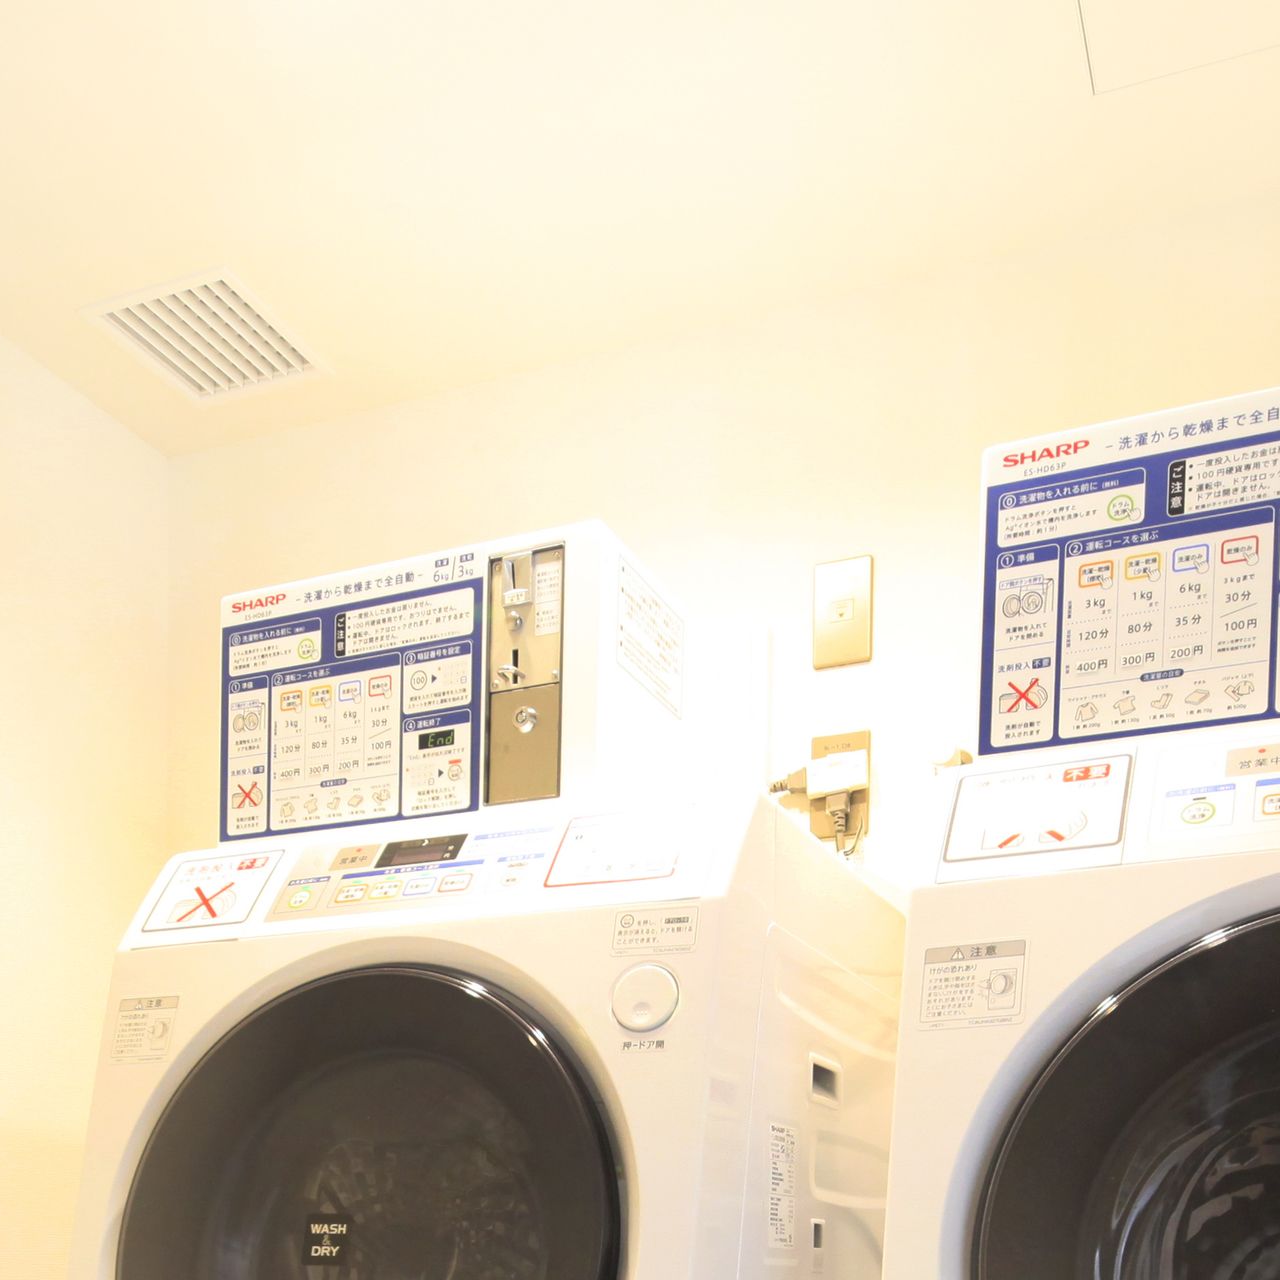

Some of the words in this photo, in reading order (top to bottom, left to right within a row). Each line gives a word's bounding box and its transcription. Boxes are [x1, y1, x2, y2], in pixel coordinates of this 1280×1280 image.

[1002, 440, 1090, 468] SHARP
[1023, 462, 1067, 477] ES-HD63P
[1019, 482, 1098, 504] 洗濯物を入れる前に
[1170, 466, 1184, 509] ご注意
[1086, 531, 1159, 551] 運転コースを選ぶ
[1017, 552, 1035, 564] 準備
[433, 570, 449, 582] 6kg
[1179, 582, 1201, 594] 6kg
[1133, 590, 1153, 601] 1kg
[1225, 591, 1252, 603] 30分
[231, 593, 286, 613] SHARP
[1085, 598, 1106, 609] 3kg
[1175, 614, 1202, 626] 35分
[1224, 618, 1258, 632] 100円
[1078, 628, 1109, 641] 120分
[1127, 622, 1153, 634] 80分
[1170, 645, 1204, 659] 200円
[1076, 659, 1108, 672] 400円
[1121, 652, 1155, 666] 300円
[428, 731, 453, 748] End
[970, 945, 997, 958] 注意
[310, 1223, 347, 1234] WASH
[311, 1246, 340, 1257] DRY
